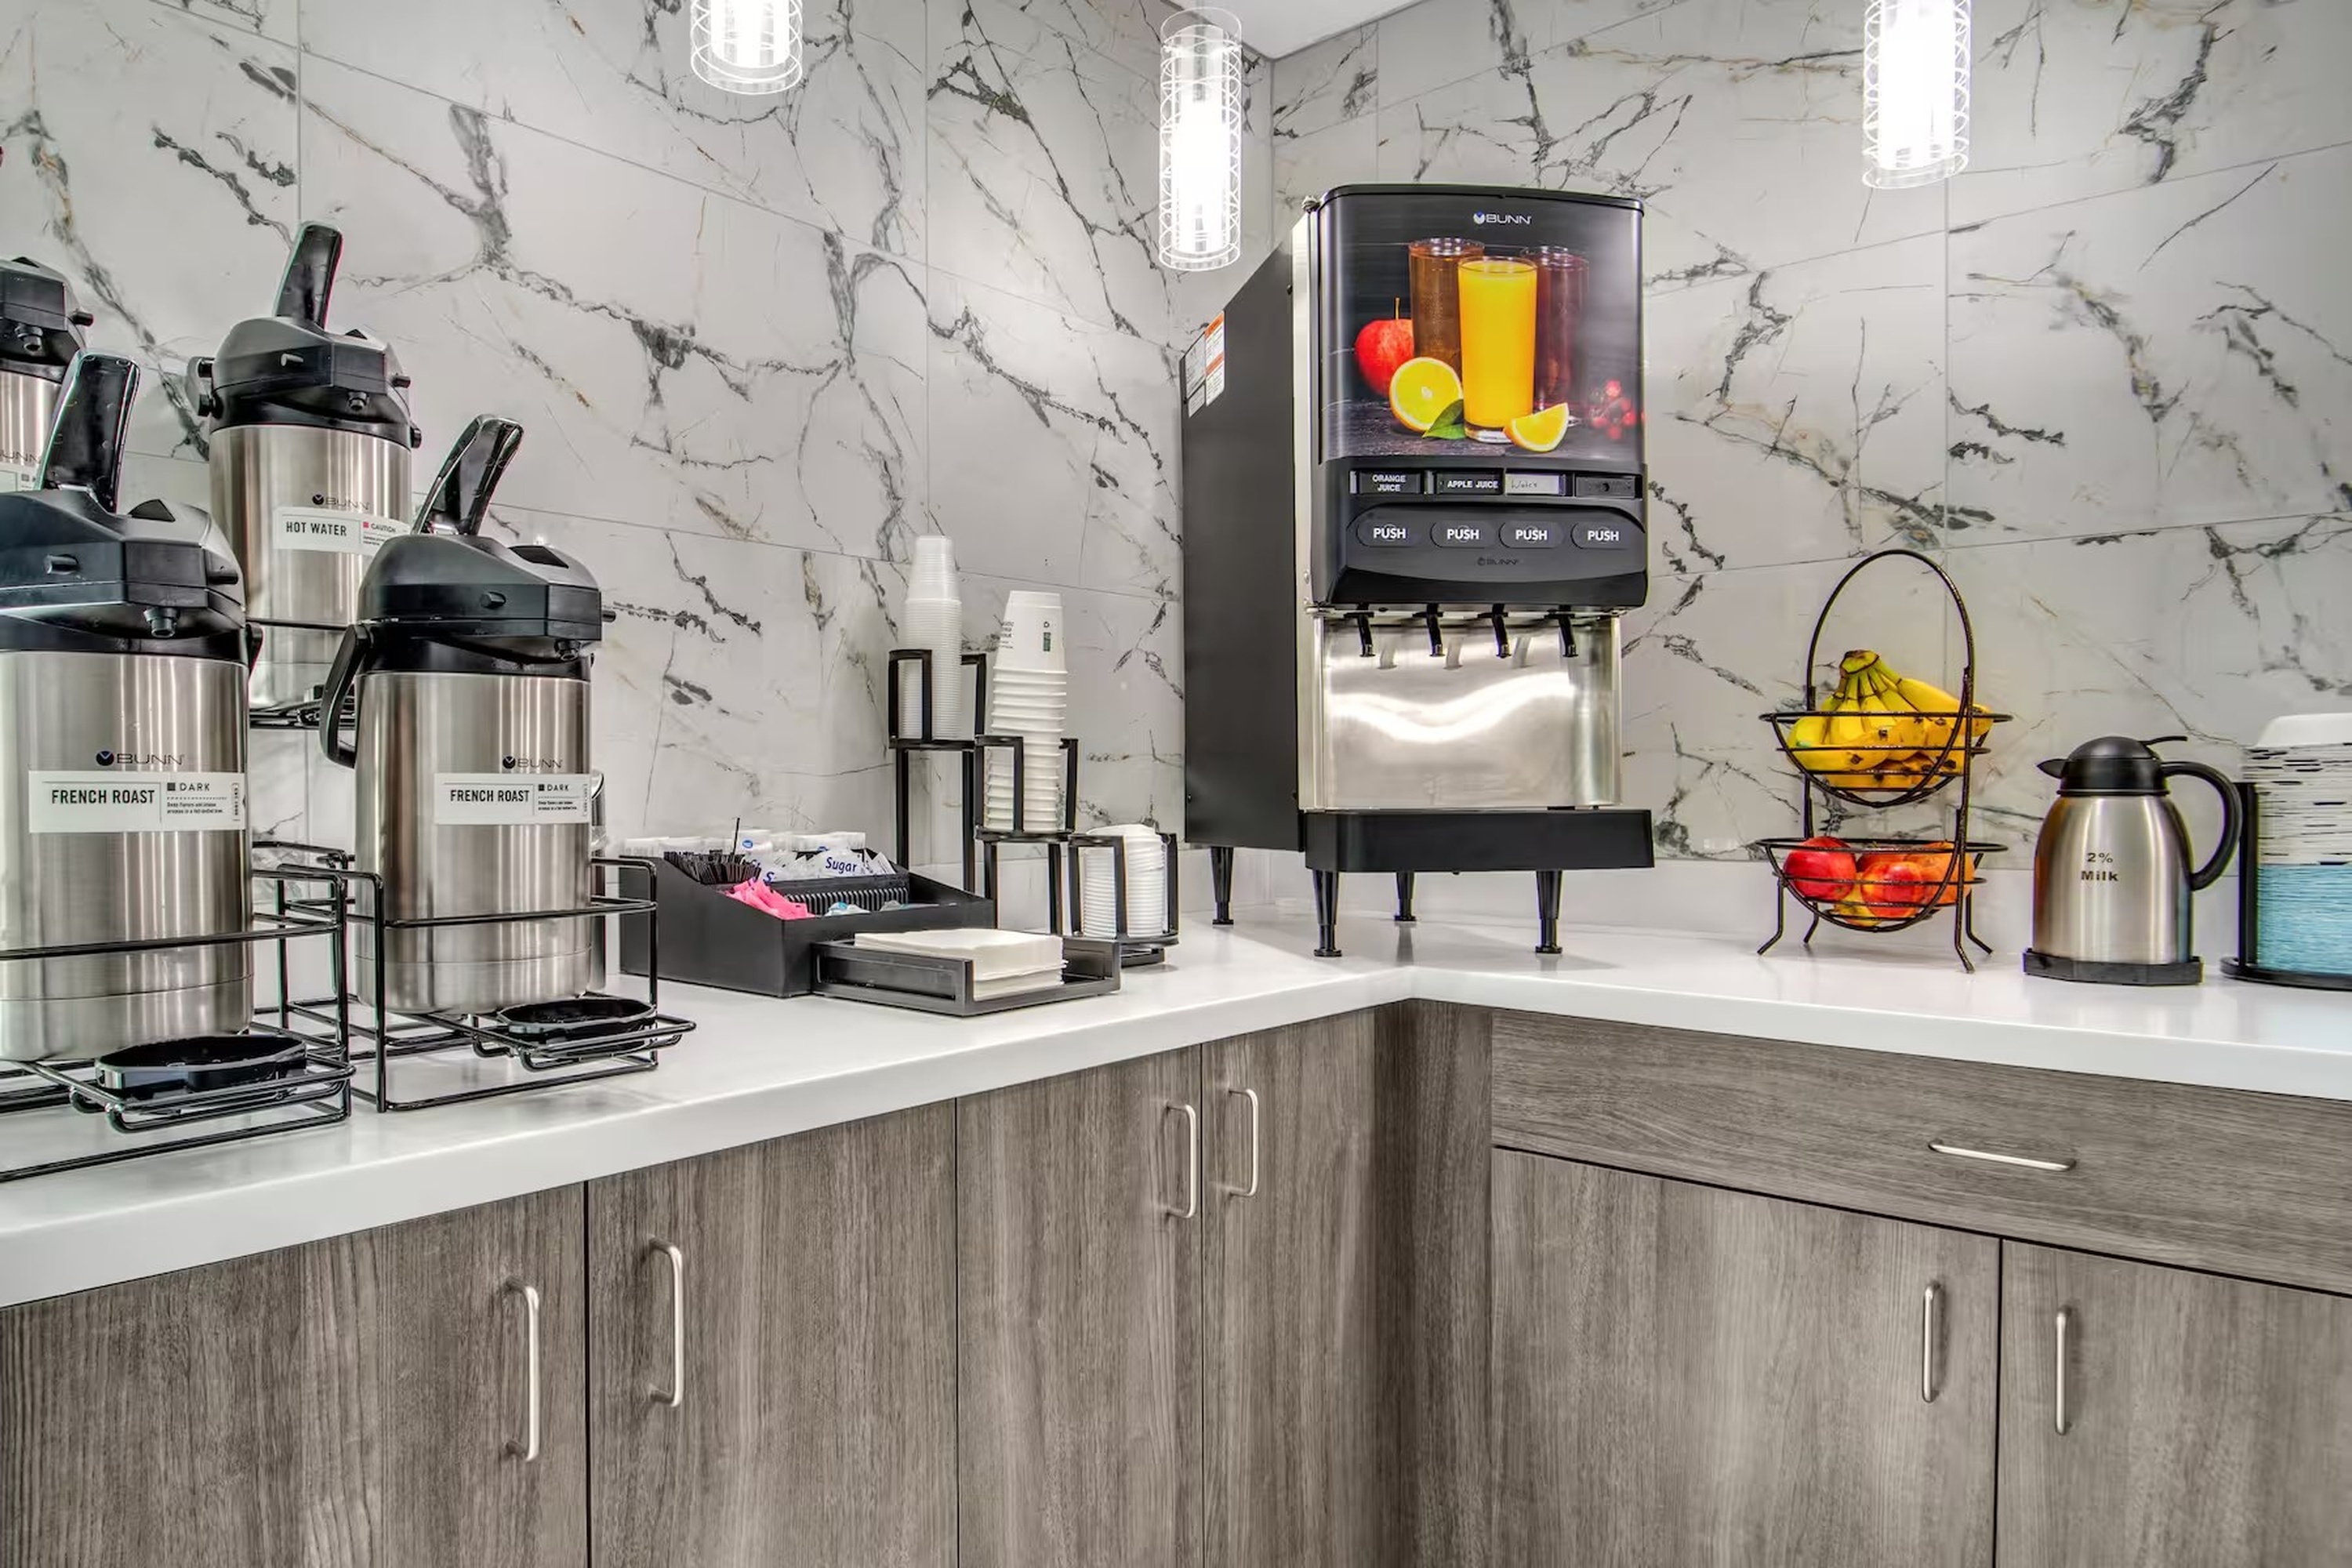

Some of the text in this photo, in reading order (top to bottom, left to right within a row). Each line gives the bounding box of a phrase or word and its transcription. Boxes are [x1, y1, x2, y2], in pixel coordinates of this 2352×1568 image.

[1485, 213, 1532, 225] BUNN
[0, 449, 42, 464] UNN
[1372, 474, 1406, 483] ORANGE
[1447, 480, 1498, 489] APPLE JUICE
[1377, 484, 1401, 492] JUICE
[325, 497, 369, 510] BUNN
[286, 521, 347, 536] HOT WATER
[1374, 528, 1406, 539] PUSH
[1447, 528, 1479, 540] PUSH
[1515, 529, 1548, 541] PUSH
[1588, 531, 1620, 542] PUSH
[117, 753, 183, 766] BUNN
[517, 758, 561, 768] BUNN
[180, 782, 210, 791] DARK
[52, 789, 154, 804] FRENCH ROAST
[450, 789, 529, 802] FRENCH ROAST
[2087, 852, 2113, 863] 2%
[826, 856, 857, 874] Sugar
[2081, 870, 2118, 881] Milk
